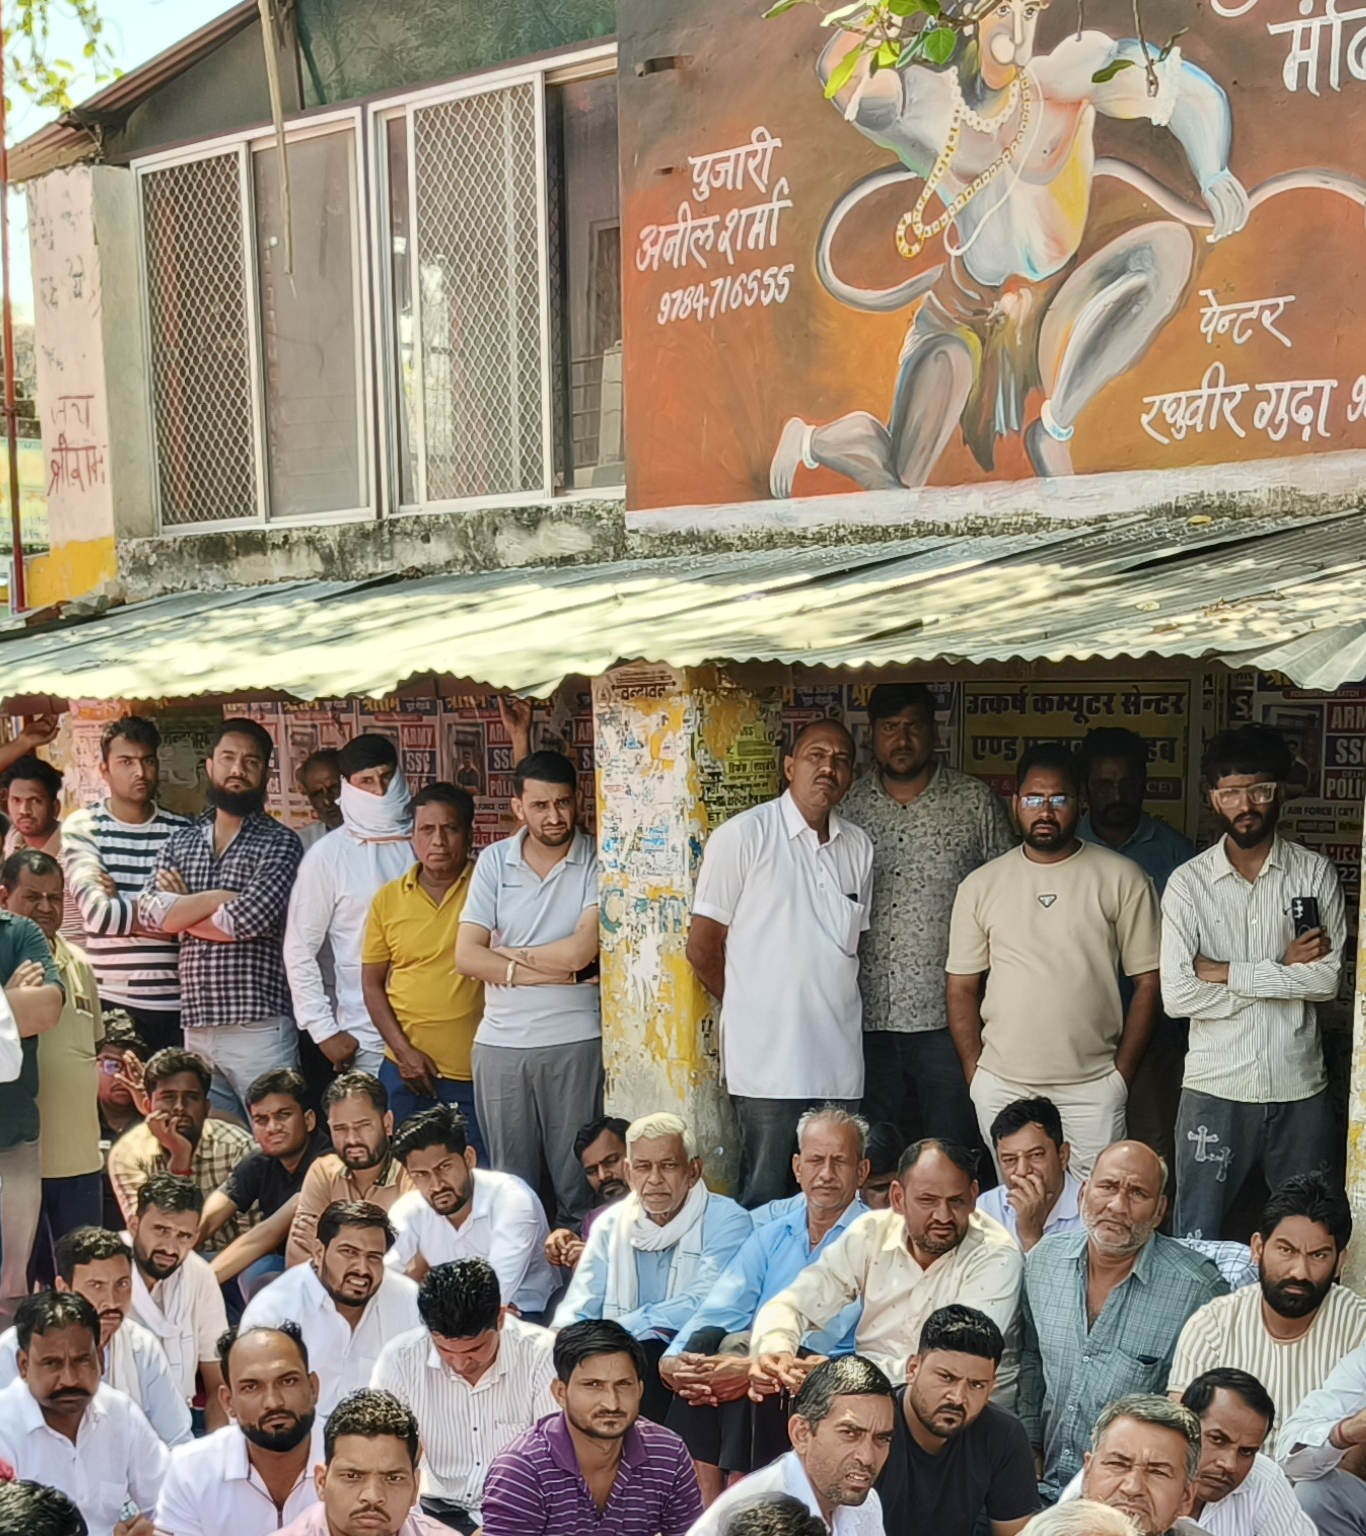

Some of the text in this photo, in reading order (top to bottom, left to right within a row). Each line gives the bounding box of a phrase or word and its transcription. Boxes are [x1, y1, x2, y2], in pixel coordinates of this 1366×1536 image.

[688, 125, 783, 202] पुजारी
[636, 176, 793, 272] अनील शर्मा
[657, 263, 795, 325] 9784716555
[1197, 288, 1296, 348] पेन्टर
[1141, 360, 1250, 446] रघुवीर
[402, 726, 434, 747] ARMY
[406, 751, 432, 773] SSC
